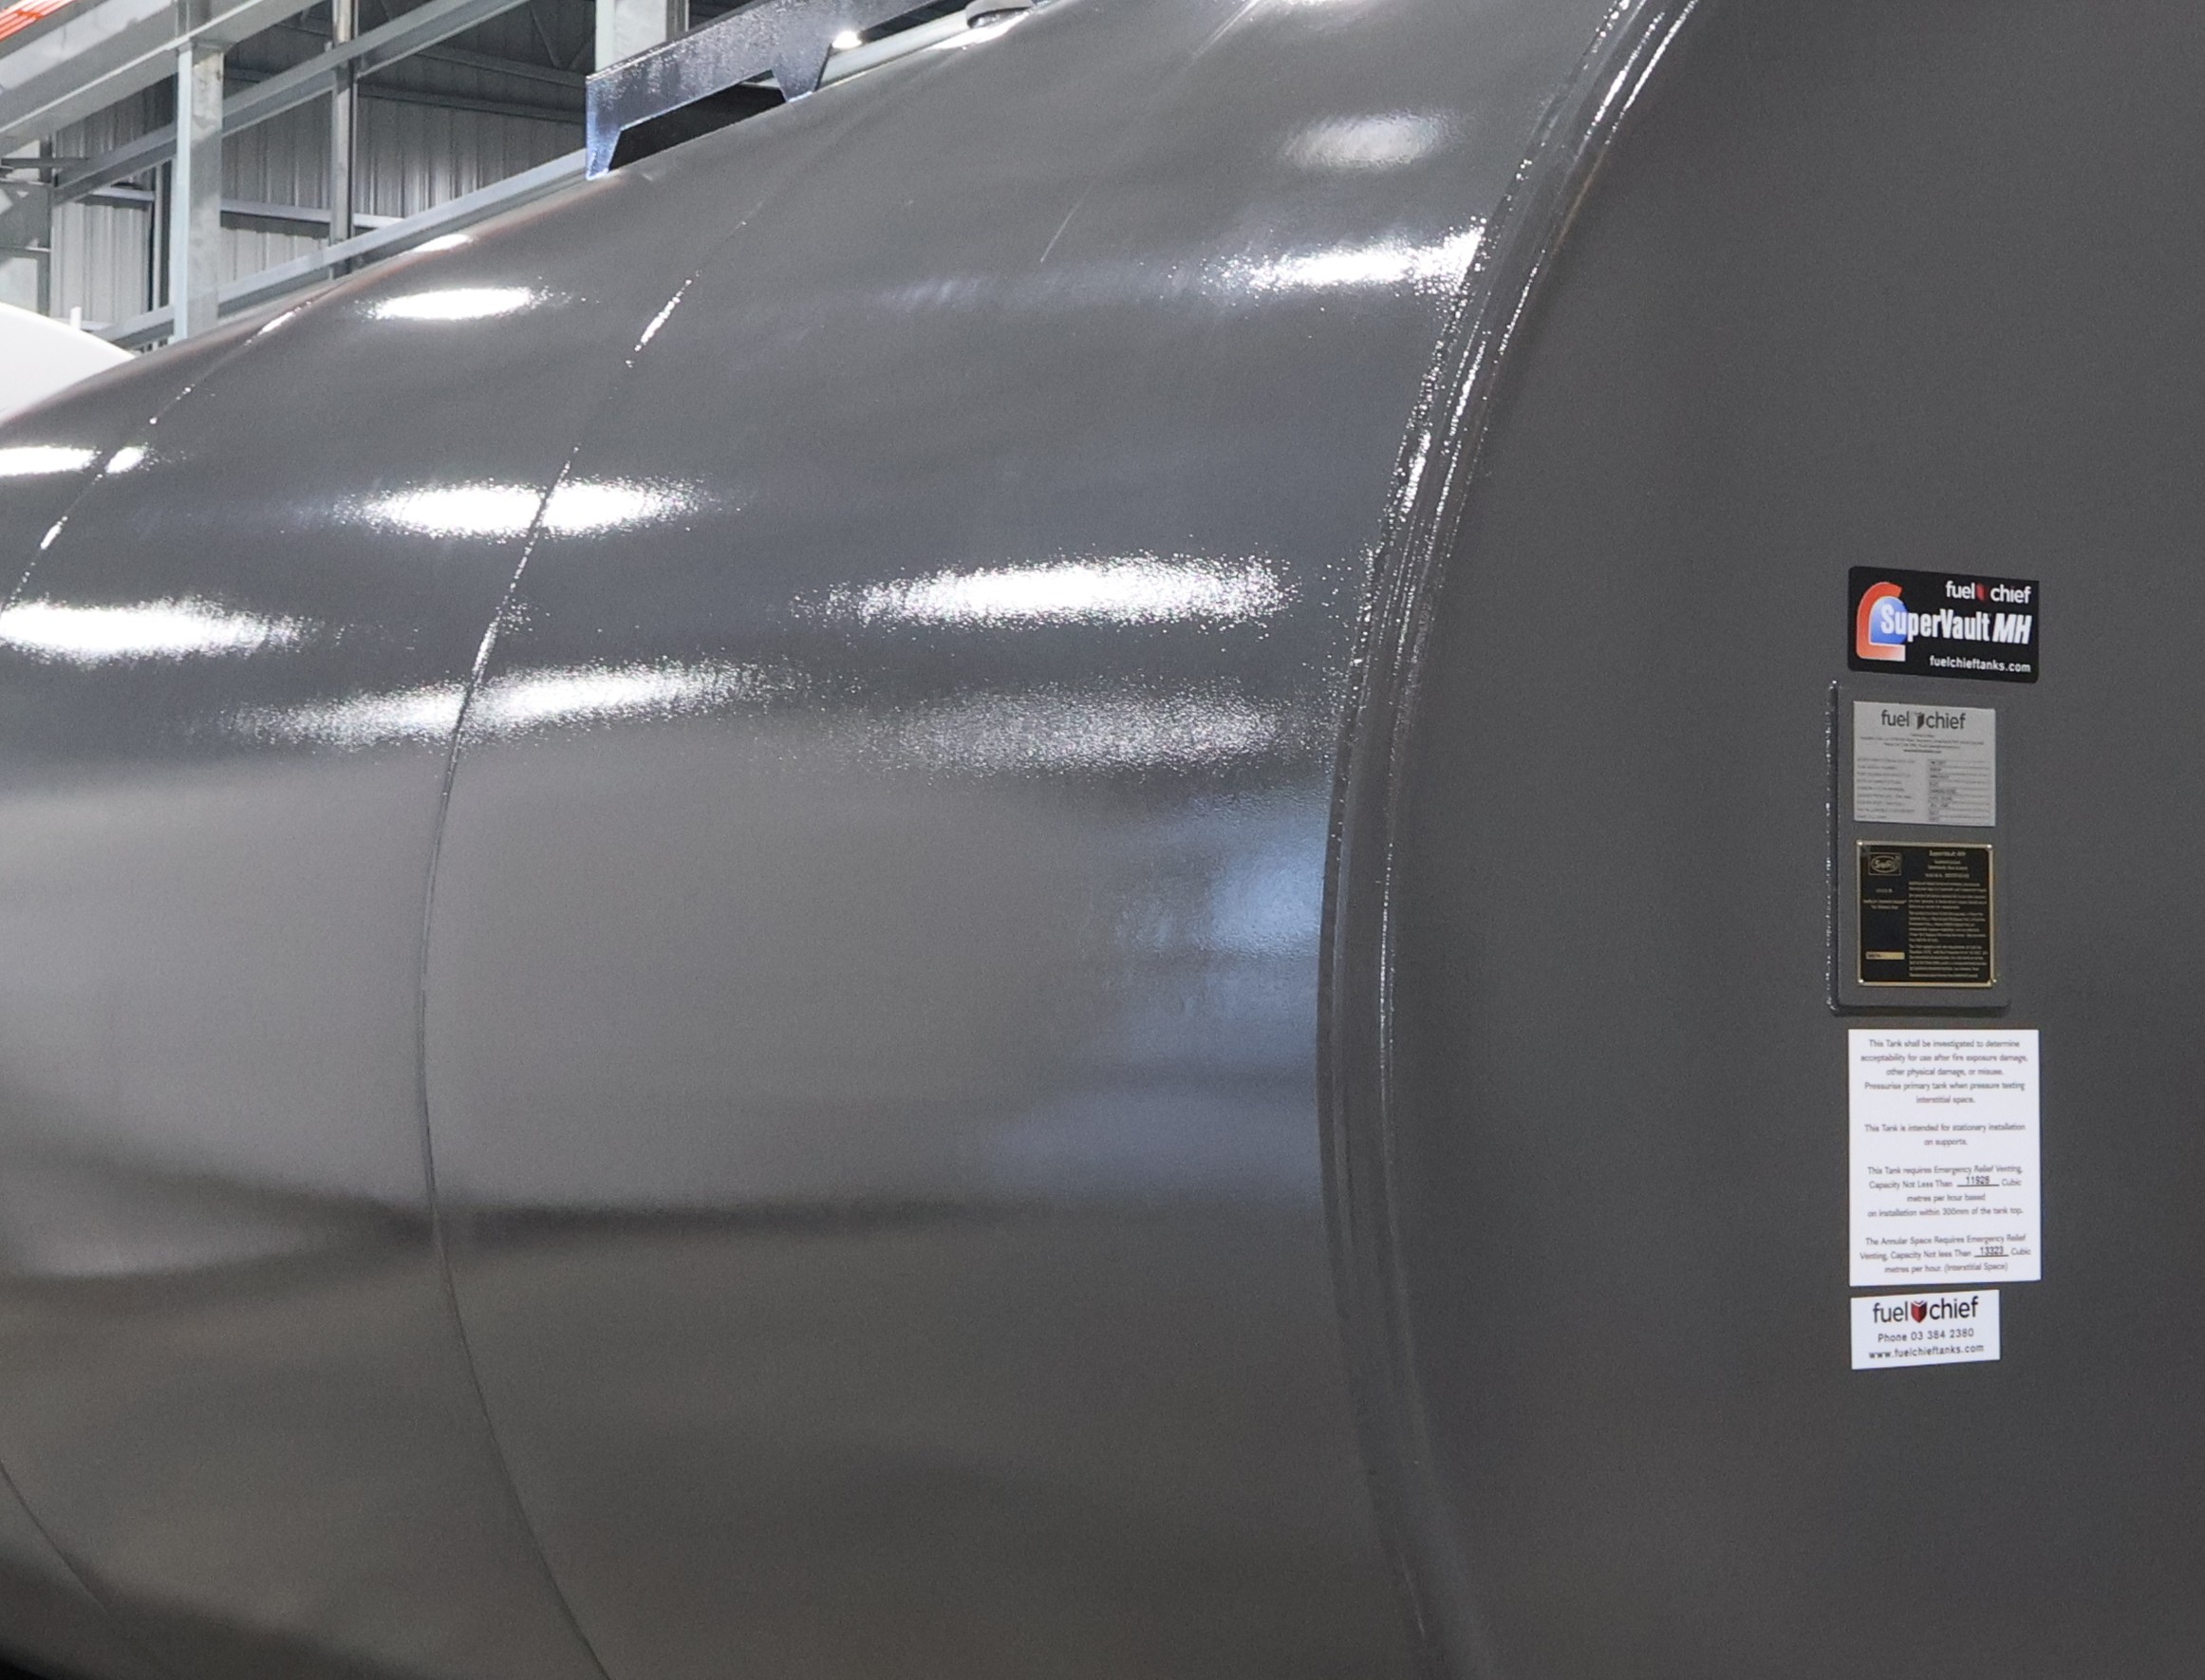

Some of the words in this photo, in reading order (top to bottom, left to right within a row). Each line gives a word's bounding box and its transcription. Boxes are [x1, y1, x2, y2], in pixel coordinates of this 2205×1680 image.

[1946, 580, 1975, 599] fuel
[1990, 584, 2031, 604] chief
[1880, 604, 1990, 642] SuperVault
[1992, 613, 2032, 644] MH
[1930, 656, 2030, 672] fuelchieftanks.com
[1881, 710, 1910, 726] fuel
[1926, 712, 1966, 729] chief
[1934, 1039, 1974, 1050] investigated
[1860, 1054, 1905, 1063] acceptability
[1999, 1054, 2027, 1063] damage,
[1907, 1068, 1934, 1077] physical
[1937, 1069, 1966, 1077] damage,
[1904, 1082, 1930, 1091] primary
[2002, 1082, 2025, 1091] testing
[1953, 1124, 1986, 1132] stationary
[1935, 1138, 1968, 1147] supports.
[1903, 1167, 1932, 1176] requires
[1934, 1167, 1971, 1176] Emergency
[1911, 1237, 1932, 1245] Space
[1934, 1237, 1964, 1245] Requires
[1967, 1236, 2005, 1244] Emergency
[1891, 1252, 1921, 1260] Capacity
[1984, 1263, 2008, 1272] Space)
[1873, 1301, 1908, 1323] fuel
[1930, 1296, 1979, 1319] chief
[1878, 1333, 1907, 1342] Phone
[1911, 1332, 1923, 1341] 03
[1928, 1331, 1945, 1339] 384
[1950, 1328, 1974, 1338] 2380
[1869, 1344, 1984, 1358] www.fuelchieftanks.com
